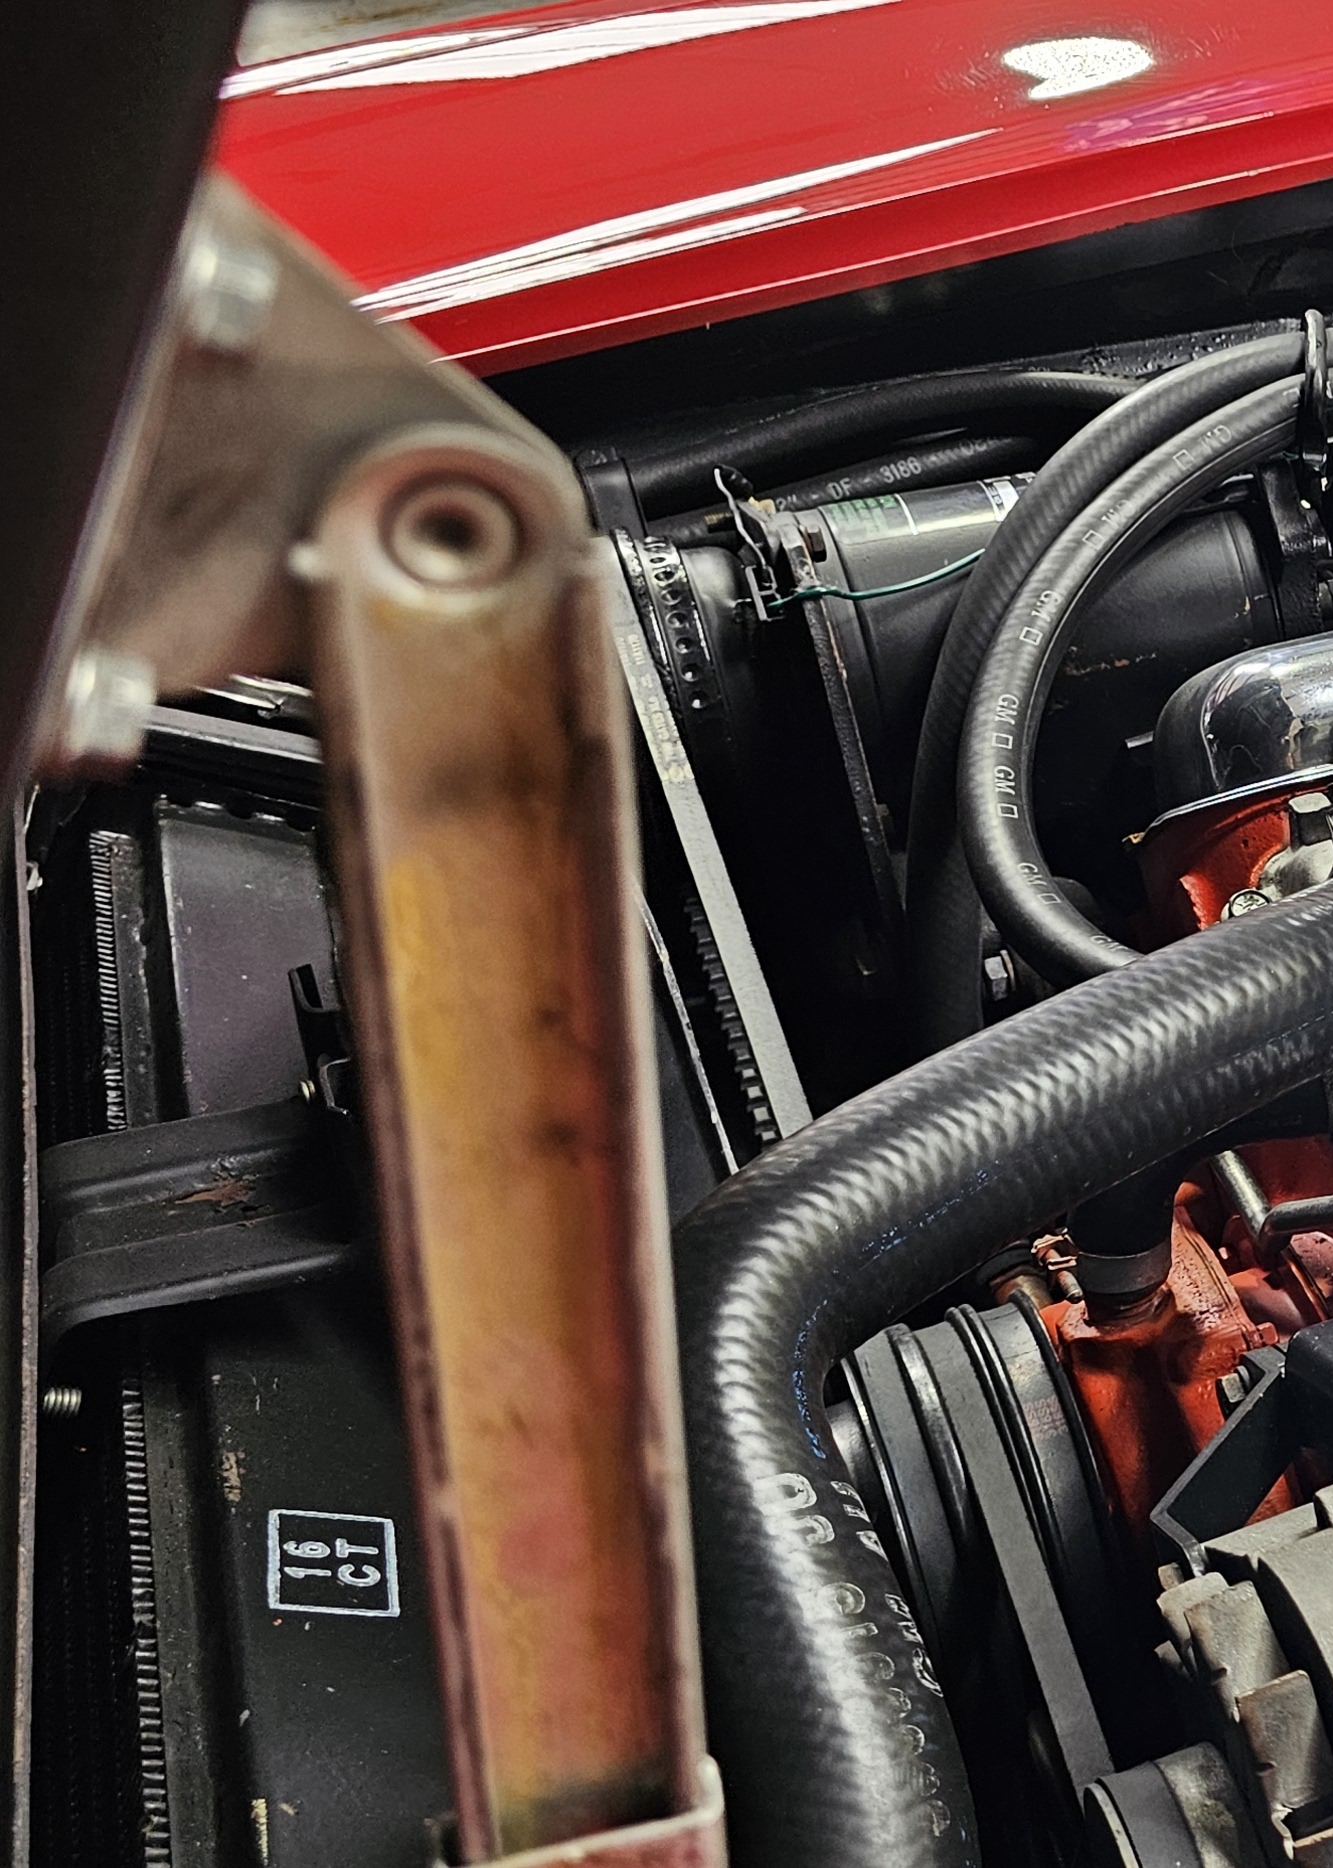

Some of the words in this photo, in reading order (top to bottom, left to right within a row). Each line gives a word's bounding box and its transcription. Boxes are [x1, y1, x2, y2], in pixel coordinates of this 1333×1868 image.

[1200, 425, 1232, 451] GM
[827, 478, 851, 500] DF
[879, 456, 922, 484] 3186
[1031, 590, 1063, 622] GM
[994, 693, 1019, 725] GM
[993, 765, 1016, 795] GM
[1017, 862, 1047, 888] GM
[282, 1540, 332, 1579] 16
[335, 1537, 381, 1587] CT
